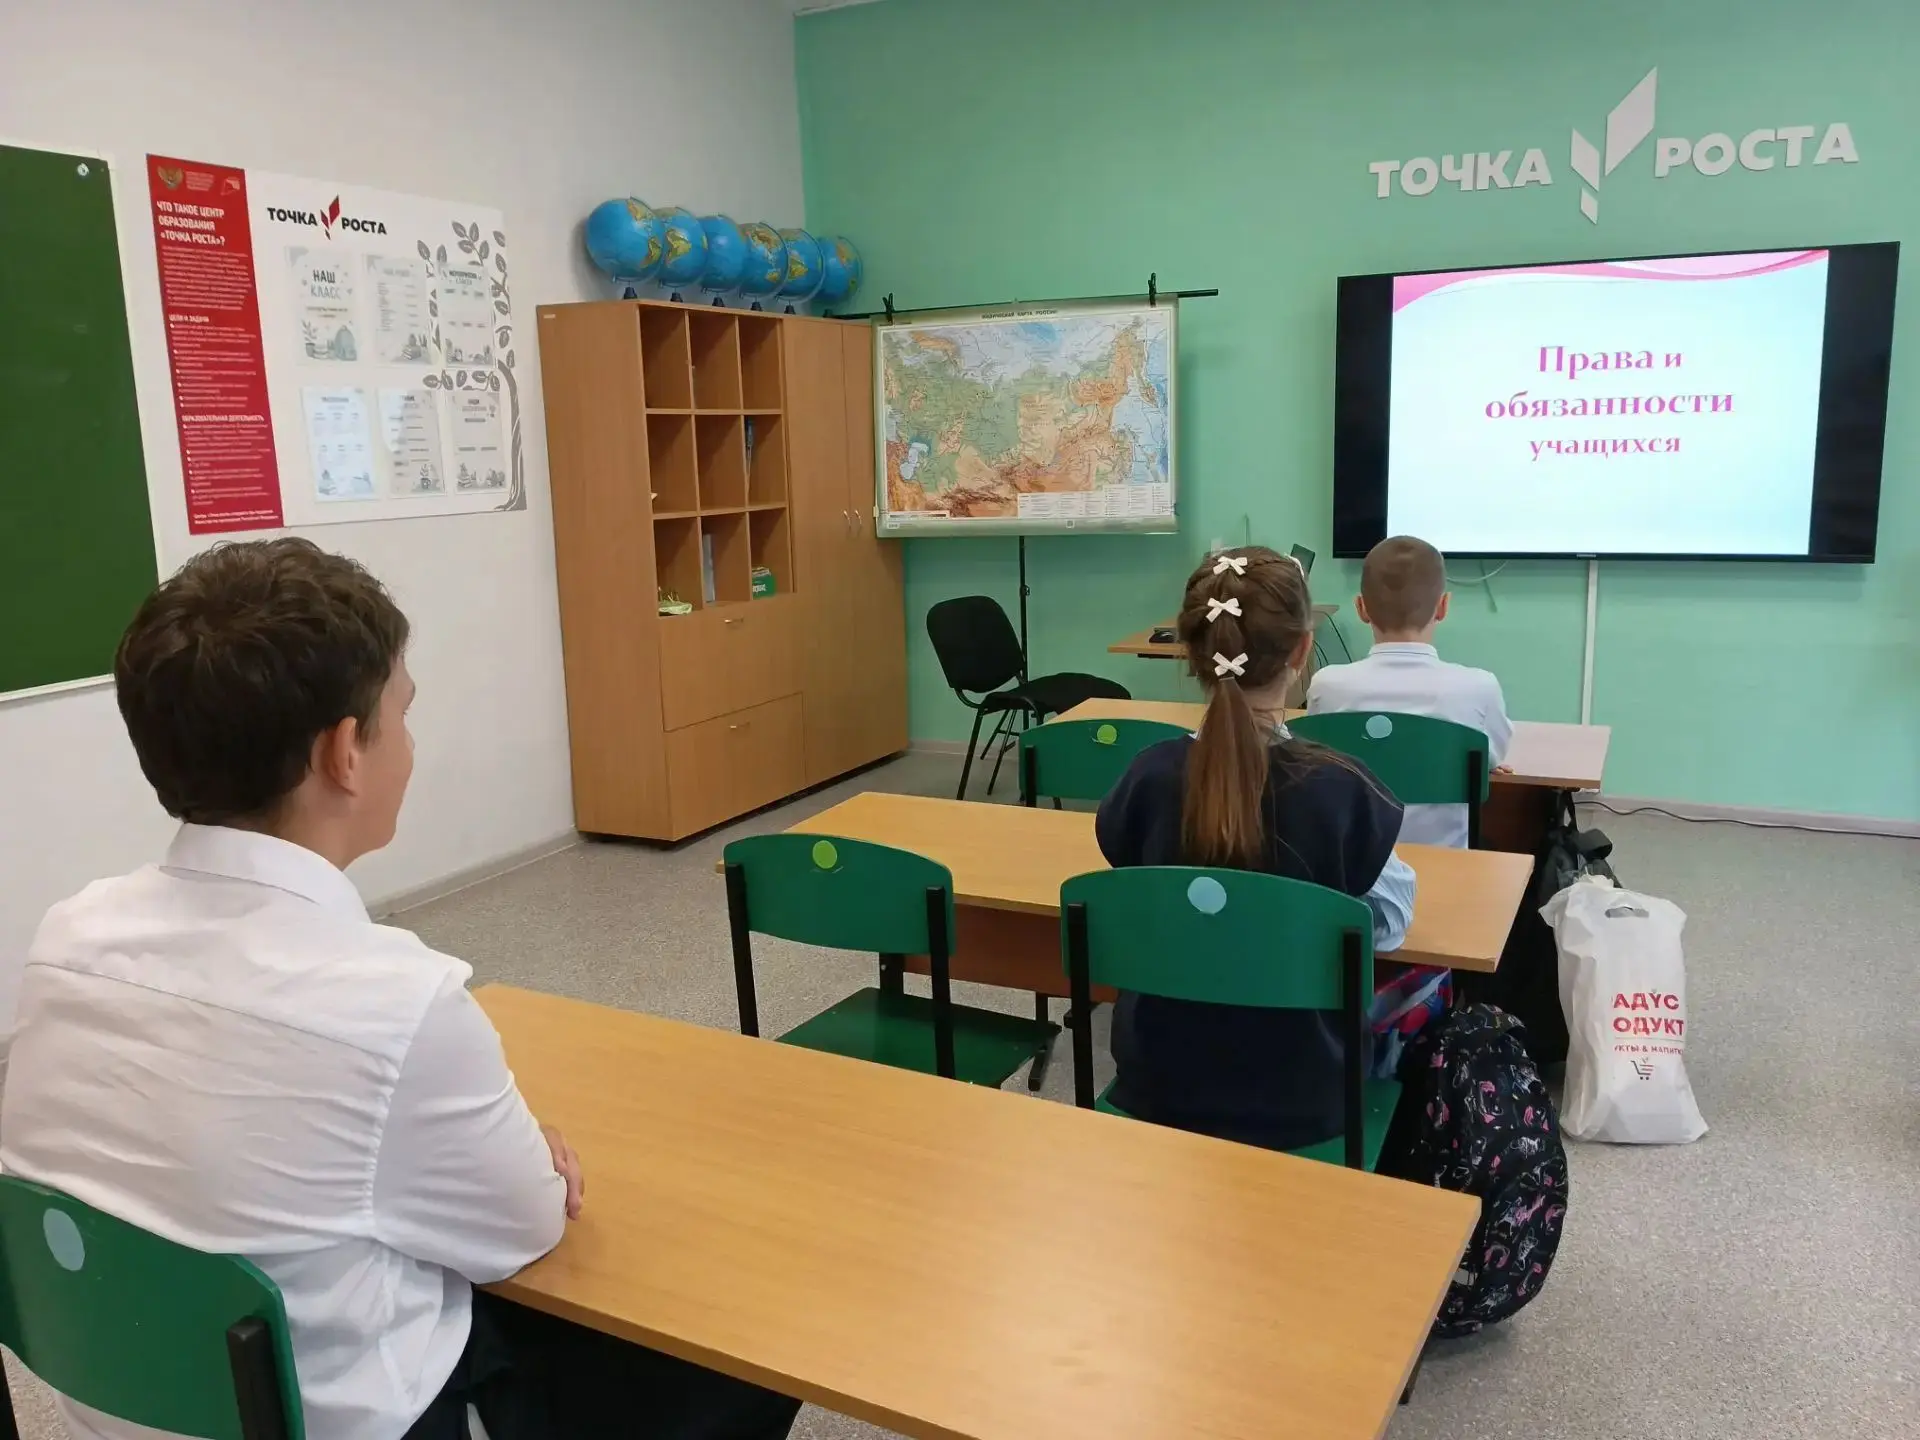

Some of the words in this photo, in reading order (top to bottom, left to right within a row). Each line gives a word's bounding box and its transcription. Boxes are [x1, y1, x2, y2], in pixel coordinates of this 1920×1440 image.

[1369, 148, 1553, 198] ТОЧКА
[1655, 122, 1859, 178] РОСТА
[157, 201, 172, 212] ЧТО
[173, 203, 199, 215] ТАКОЕ
[200, 207, 225, 218] ЦЕНТР
[267, 207, 318, 226] ТОЧКА
[341, 217, 387, 235] РОСТА
[159, 215, 215, 231] ОБРАЗОВАНИЯ
[313, 269, 335, 283] НАШ
[310, 285, 341, 300] КЛАСС
[1537, 344, 1654, 380] Права
[1664, 352, 1683, 369] и
[1484, 390, 1735, 420] обязанности
[1529, 435, 1682, 462] учащихся
[1613, 1016, 1685, 1036] ОДУКТ
